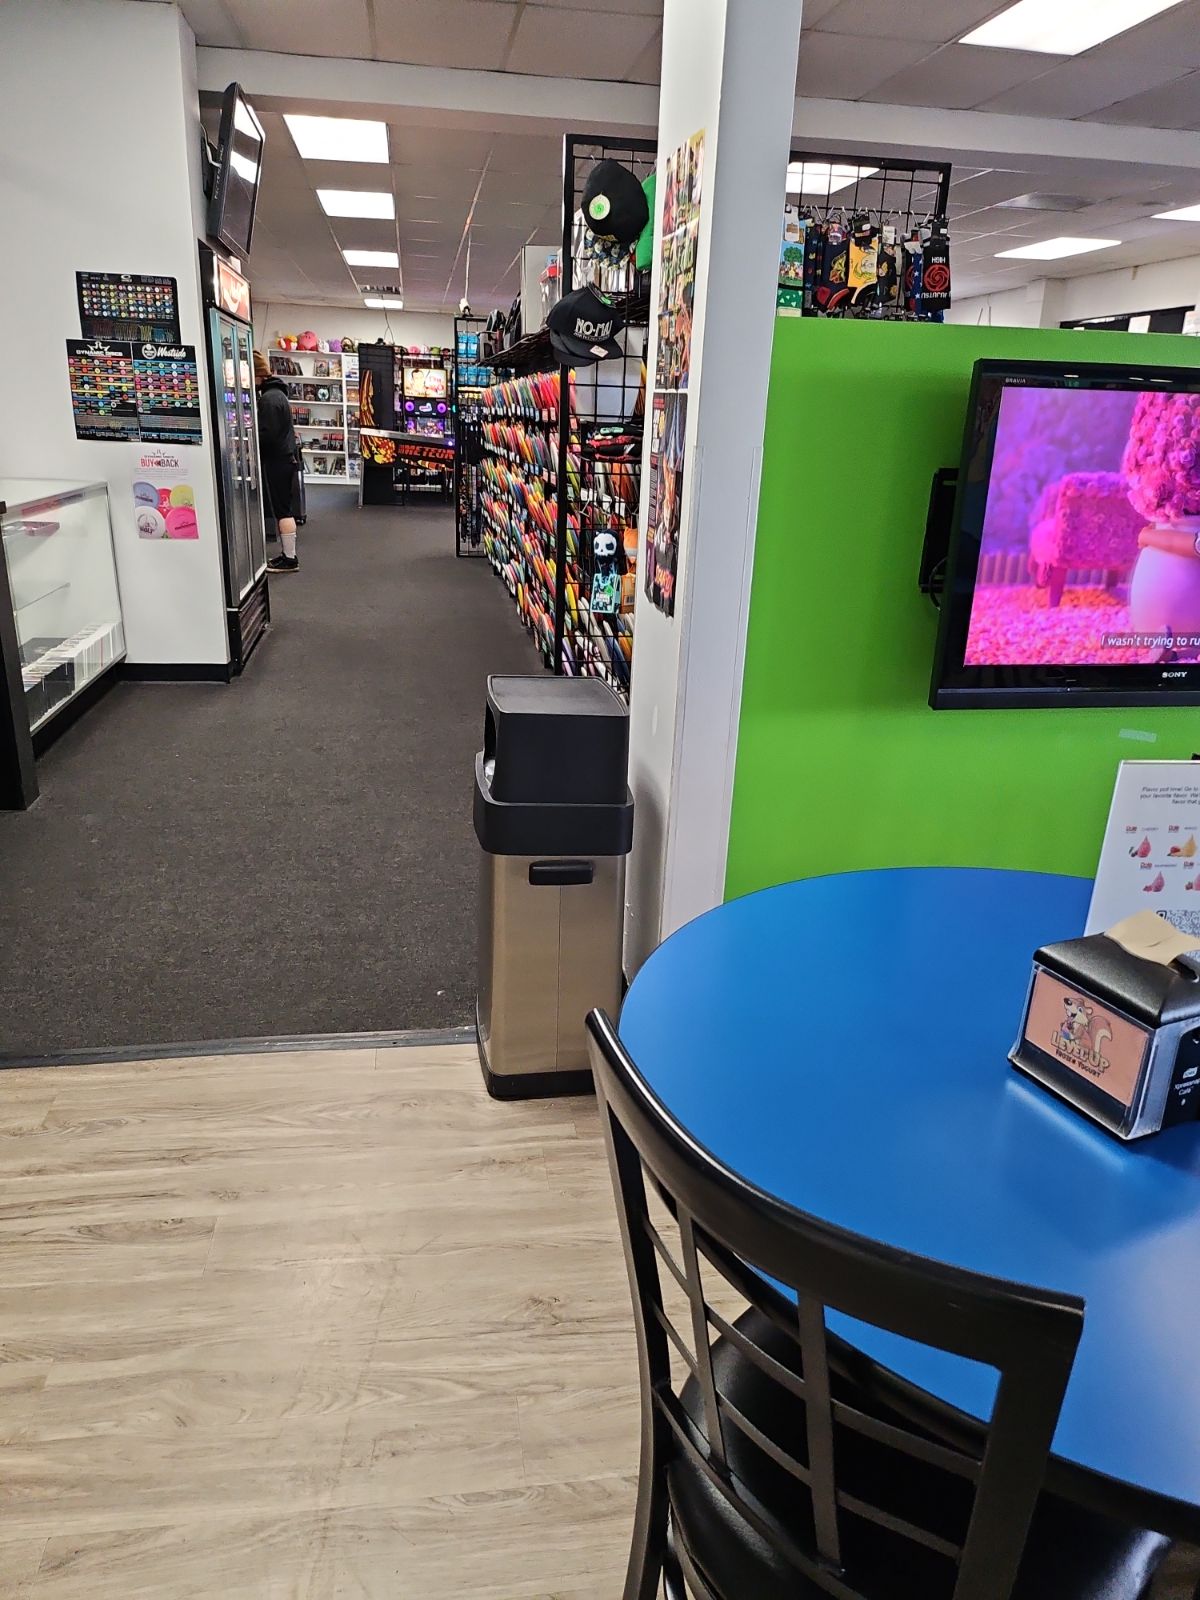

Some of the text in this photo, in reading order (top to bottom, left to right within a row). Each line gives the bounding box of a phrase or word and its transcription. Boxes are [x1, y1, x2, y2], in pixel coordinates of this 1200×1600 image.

[157, 346, 187, 358] Westside
[398, 444, 455, 460] METEOR
[140, 458, 180, 468] BUY BACK
[1101, 635, 1105, 646] I
[1107, 634, 1141, 646] wasn't
[1143, 635, 1174, 649] trying
[1176, 636, 1188, 646] to
[1162, 671, 1188, 679] SONY
[1051, 1030, 1111, 1074] LEVEL UP
[1077, 1060, 1101, 1078] YOGURT
